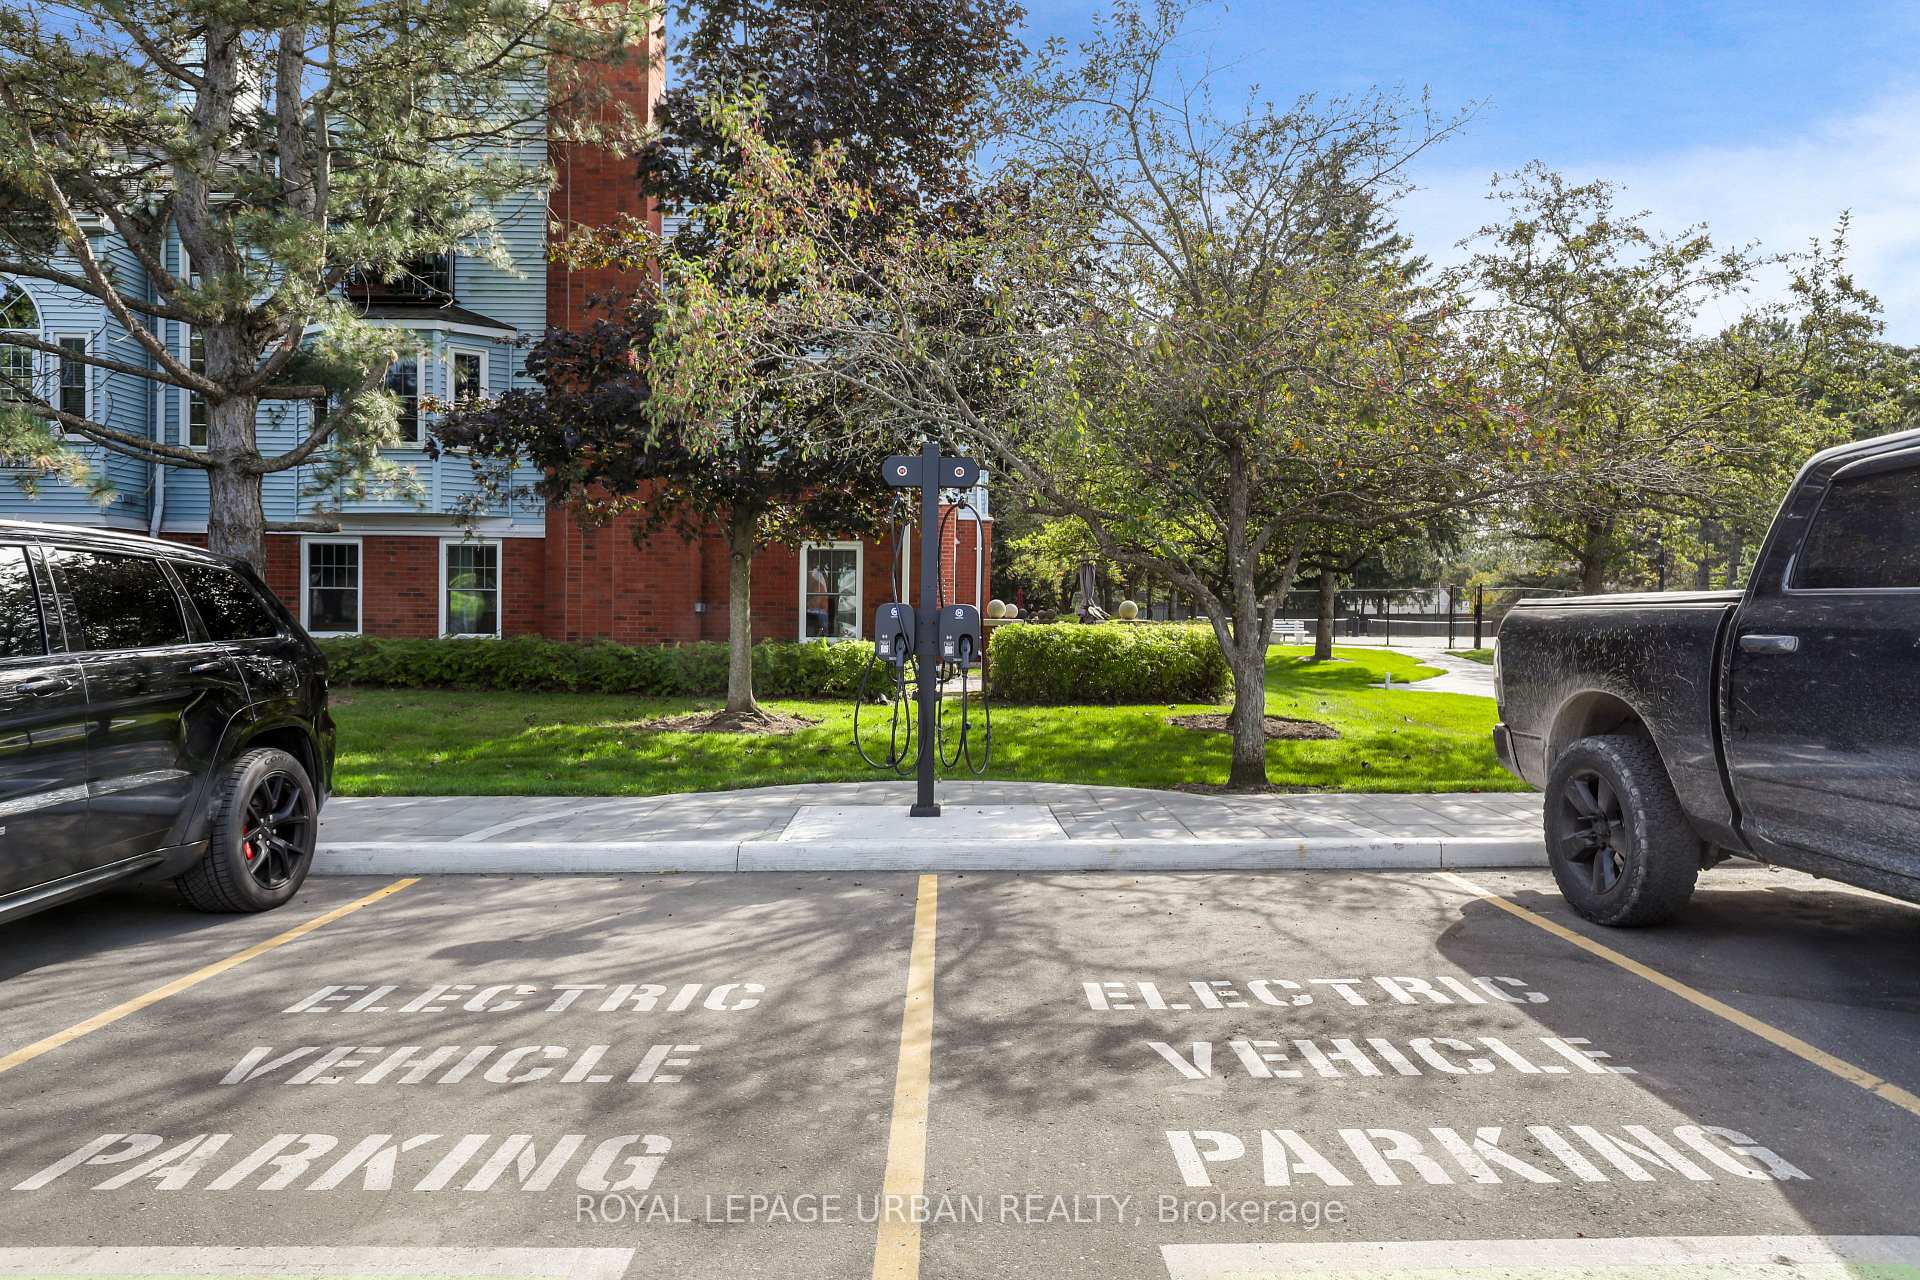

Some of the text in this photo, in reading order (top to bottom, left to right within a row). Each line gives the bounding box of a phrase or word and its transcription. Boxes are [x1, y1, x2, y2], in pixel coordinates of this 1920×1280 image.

[282, 983, 765, 1013] ELECTRIC
[1081, 976, 1549, 1011] ELECTRIC
[219, 1045, 700, 1085] VEHICLE
[1147, 1037, 1637, 1080] VEHICLE
[11, 1134, 673, 1192] PARKING
[1165, 1125, 1813, 1188] PARKING
